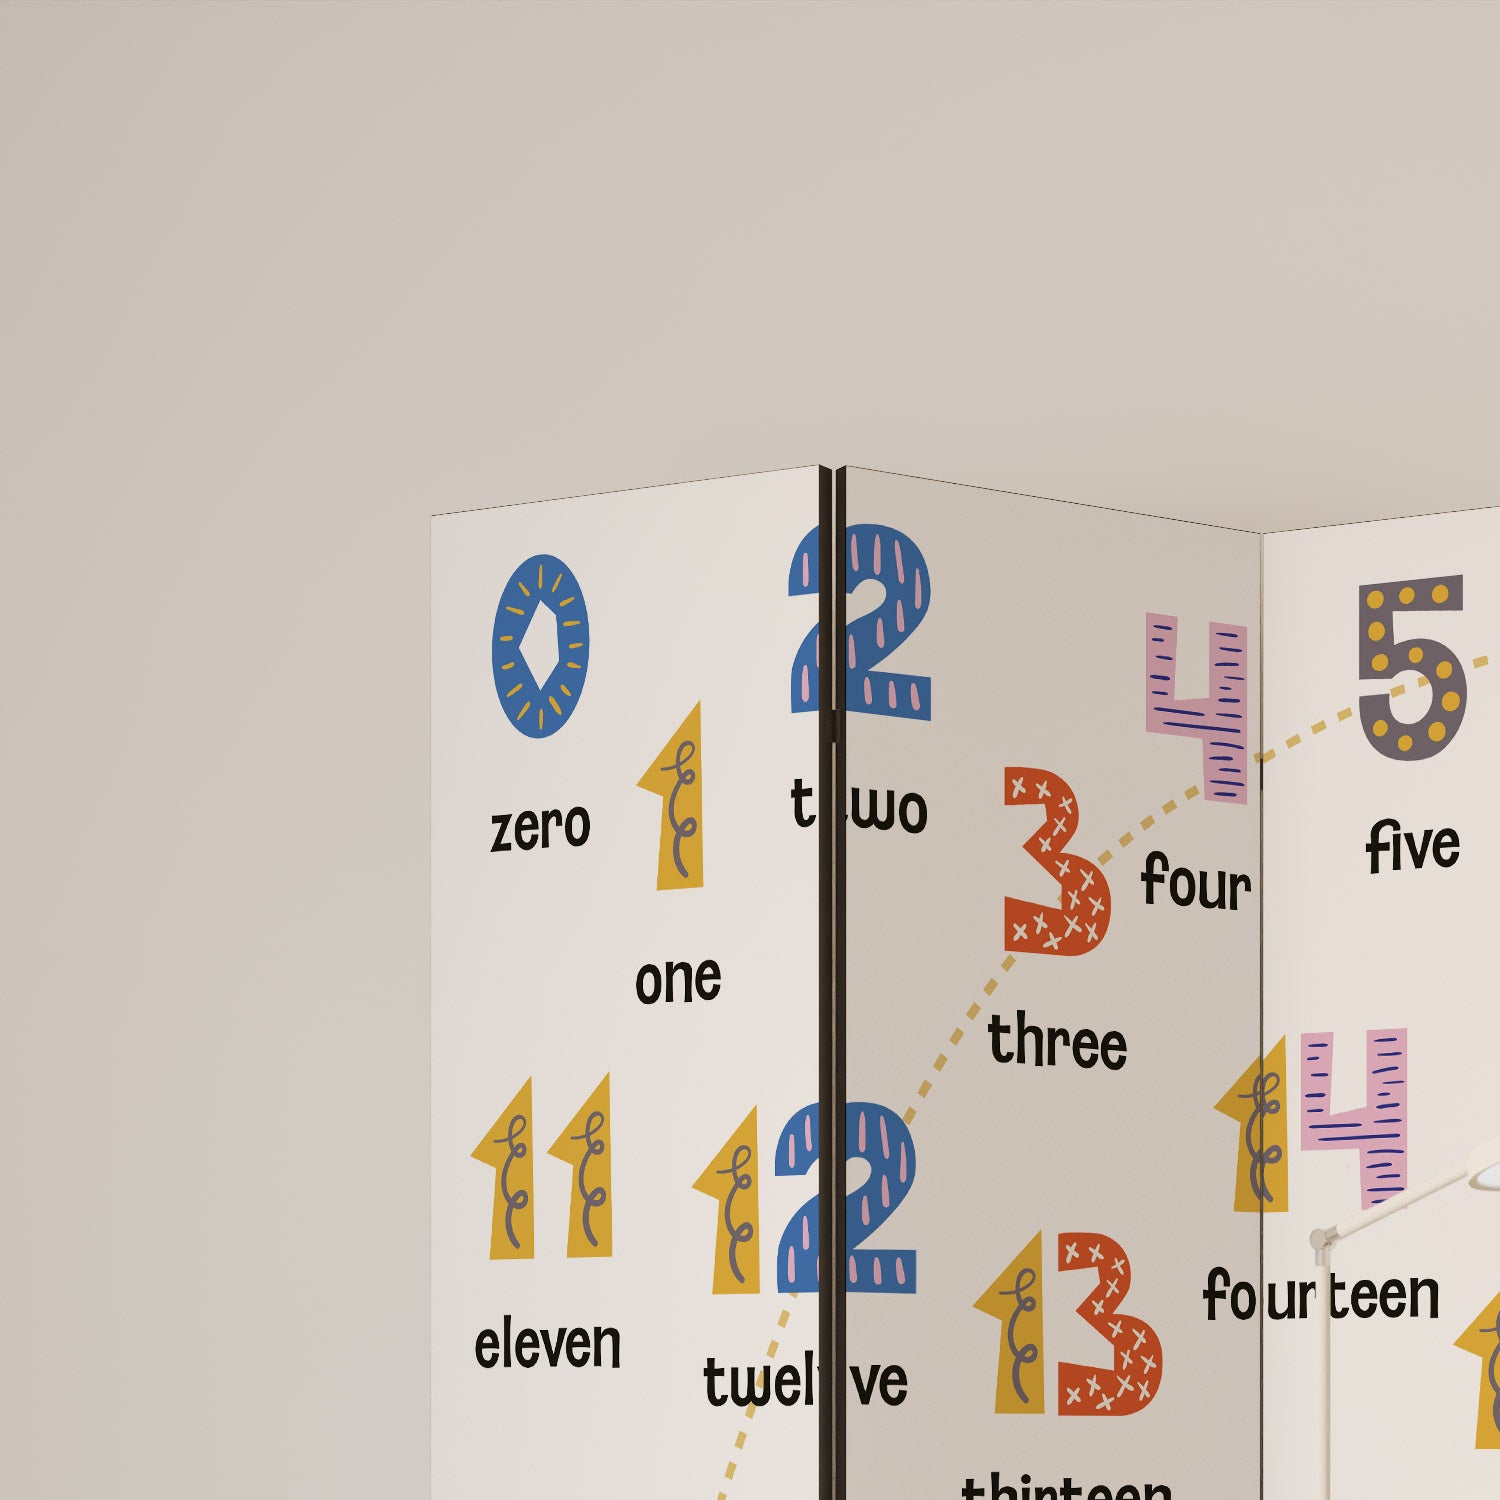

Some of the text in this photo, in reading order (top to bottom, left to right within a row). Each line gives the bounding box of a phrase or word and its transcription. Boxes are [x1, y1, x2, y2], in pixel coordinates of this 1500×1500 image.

[492, 554, 590, 738] 0
[788, 524, 931, 721] 2
[1146, 613, 1248, 804] 4
[1359, 576, 1467, 761] 5
[491, 807, 590, 852] zero
[637, 702, 703, 890] 1
[791, 779, 927, 833] two
[1005, 768, 1110, 956] 3
[1141, 851, 1251, 910] four
[1366, 818, 1459, 874] five
[636, 960, 720, 1004] one
[988, 1010, 1127, 1070] three
[472, 1074, 612, 1260] 11
[693, 1102, 916, 1294] 12
[1213, 1028, 1408, 1214] 14
[475, 1315, 620, 1368] eleven
[704, 1350, 907, 1406] twelve
[974, 1232, 1162, 1415] 13
[1203, 1266, 1438, 1320] fourteen
